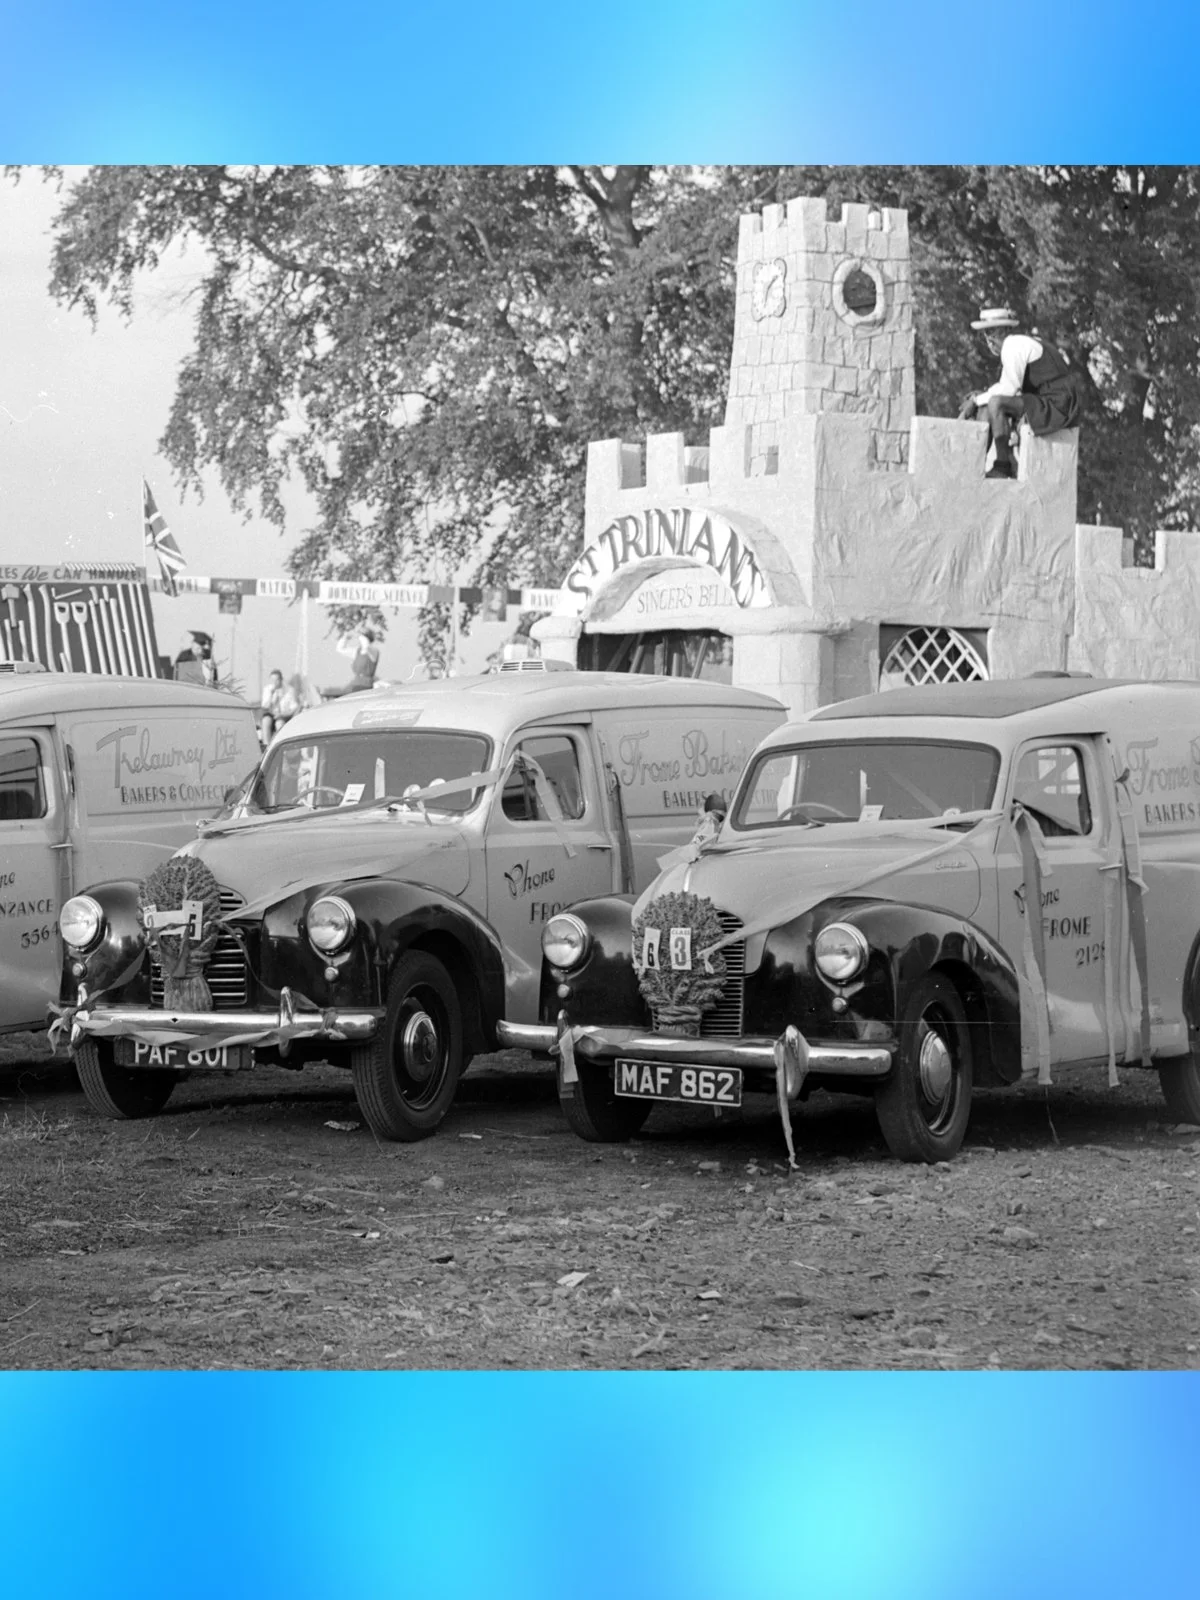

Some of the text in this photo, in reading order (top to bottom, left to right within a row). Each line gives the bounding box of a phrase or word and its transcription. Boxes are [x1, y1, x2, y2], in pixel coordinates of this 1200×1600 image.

[21, 565, 49, 581] We
[53, 567, 82, 580] CAN
[96, 725, 206, 789] Trelawney
[619, 730, 681, 786] Frome
[1126, 737, 1190, 796] Frome
[121, 785, 167, 804] BAKERS
[169, 785, 177, 800] &
[663, 789, 707, 808] BAKERS
[1144, 802, 1195, 823] BAKERS
[504, 860, 555, 897] Phone
[188, 914, 197, 938] 5
[647, 942, 655, 967] 6
[674, 936, 687, 967] 3
[135, 1041, 177, 1065] PAF
[622, 1063, 734, 1101] MAF 862
